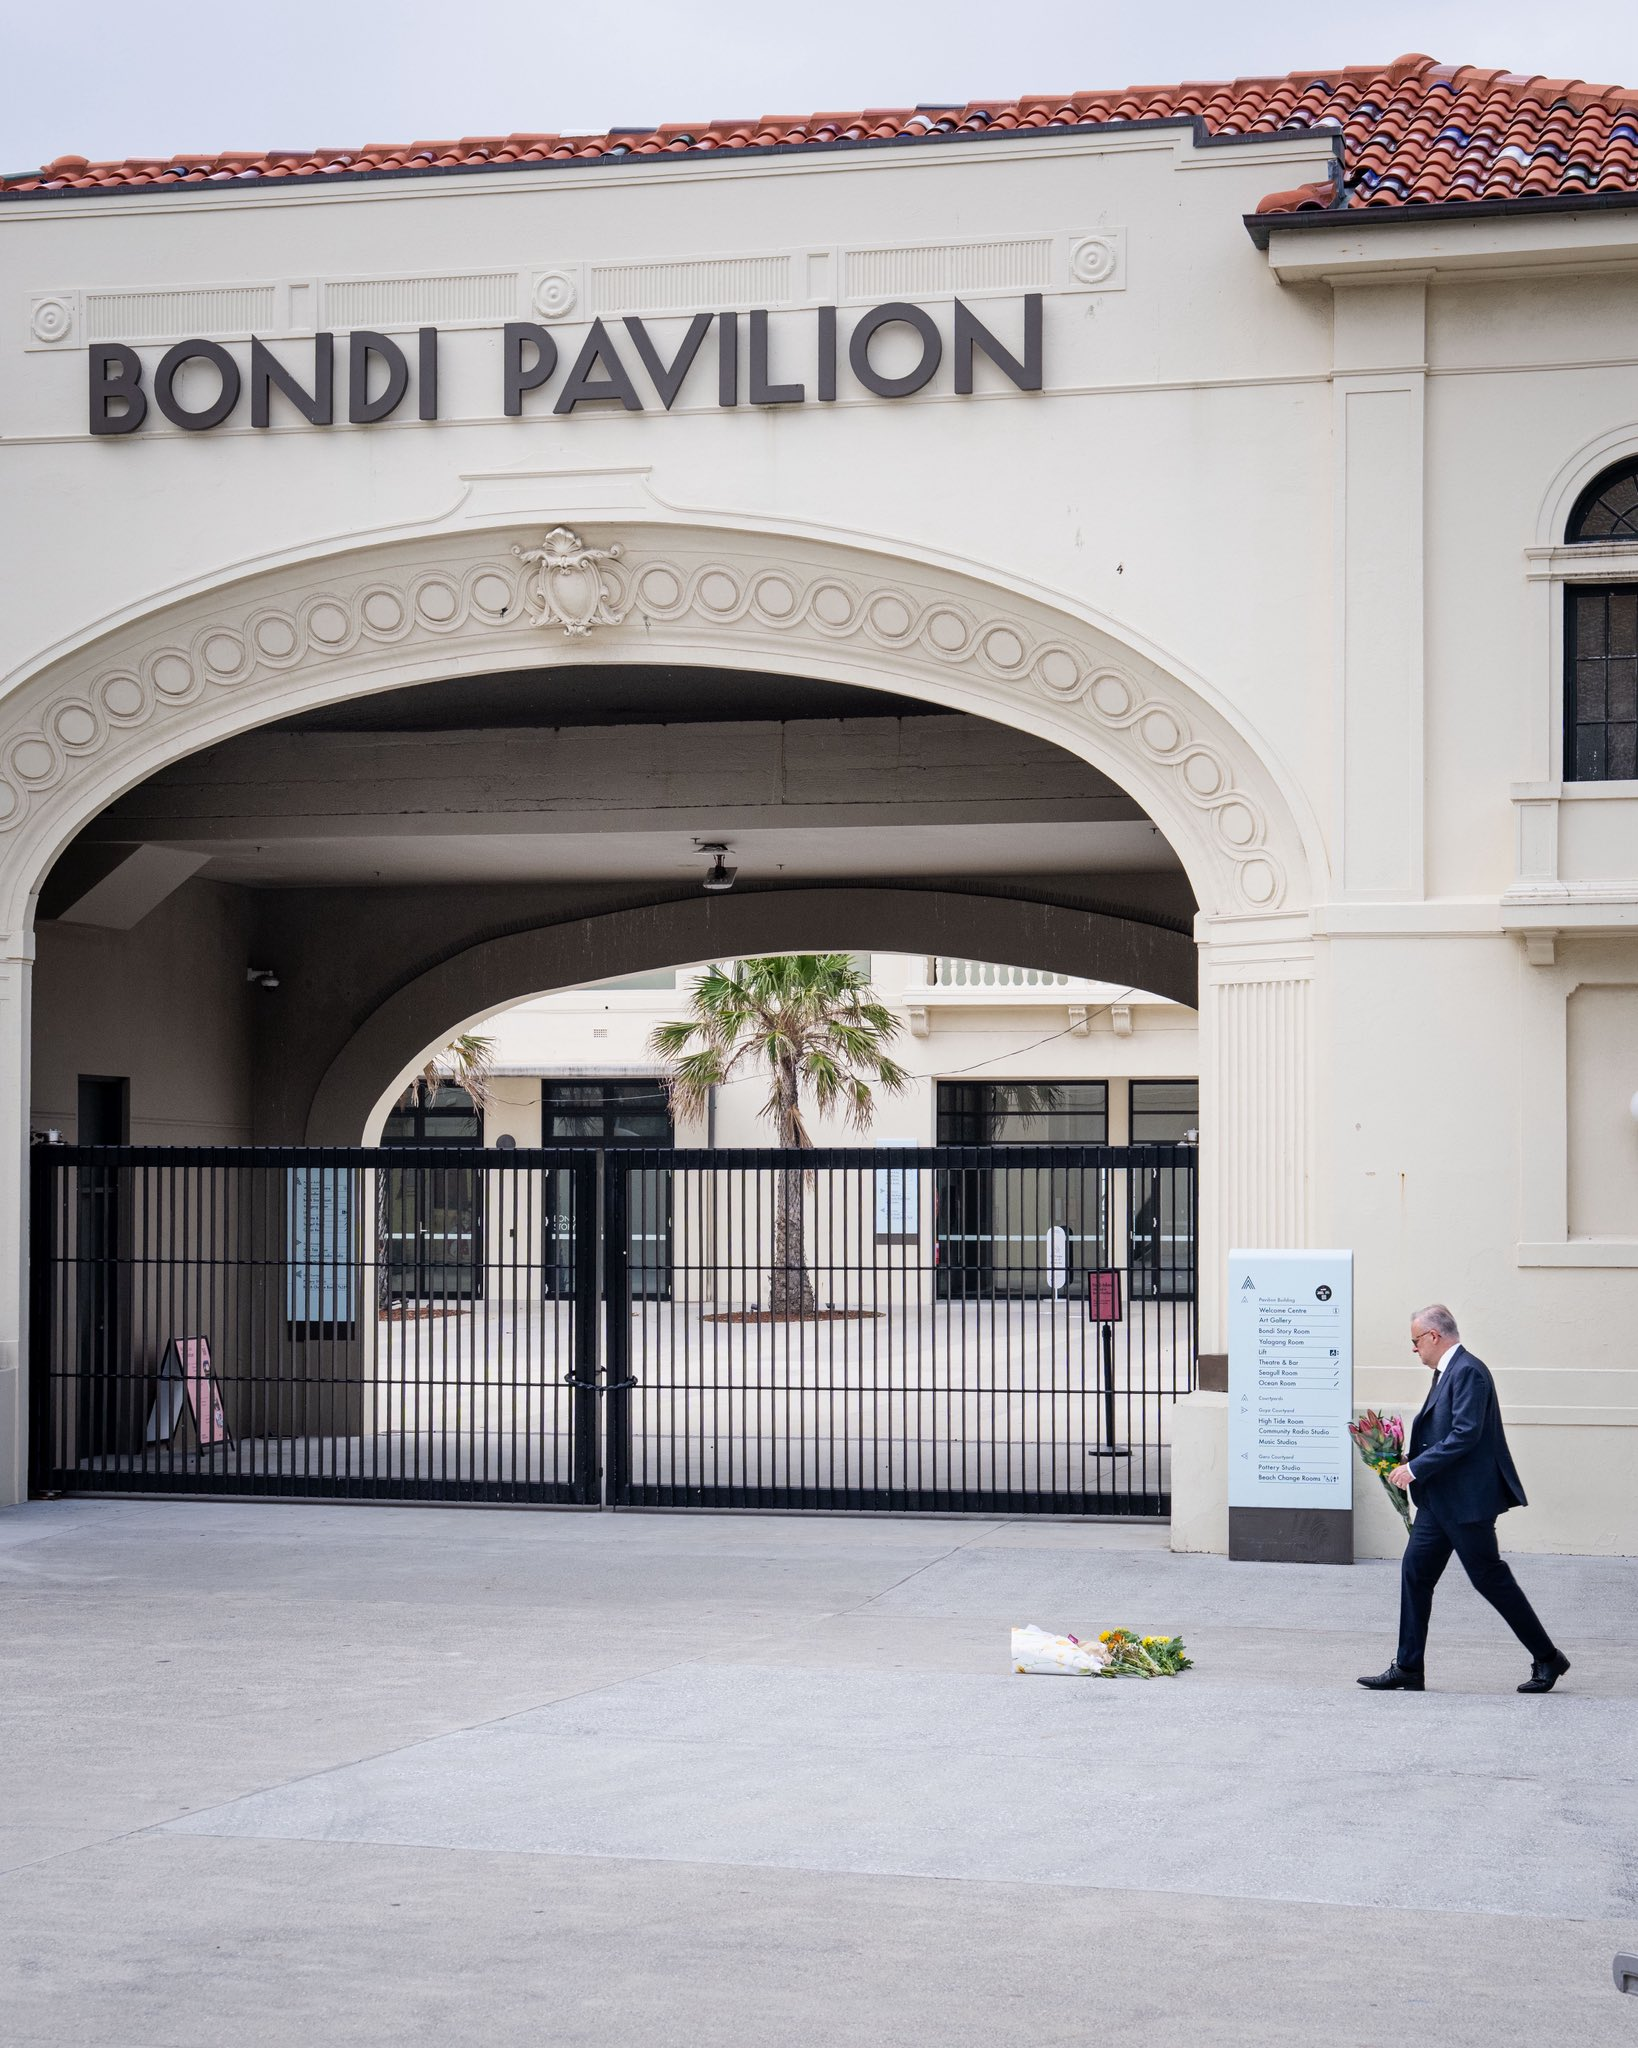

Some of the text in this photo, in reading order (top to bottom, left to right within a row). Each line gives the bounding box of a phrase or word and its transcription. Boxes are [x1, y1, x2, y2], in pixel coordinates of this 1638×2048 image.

[89, 293, 1043, 435] BONDI PAVILION
[1270, 1317, 1292, 1325] Gallery
[1259, 1369, 1280, 1377] Seagull
[1258, 1418, 1272, 1426] High
[1258, 1428, 1291, 1436] Community
[1258, 1464, 1279, 1472] Pottery
